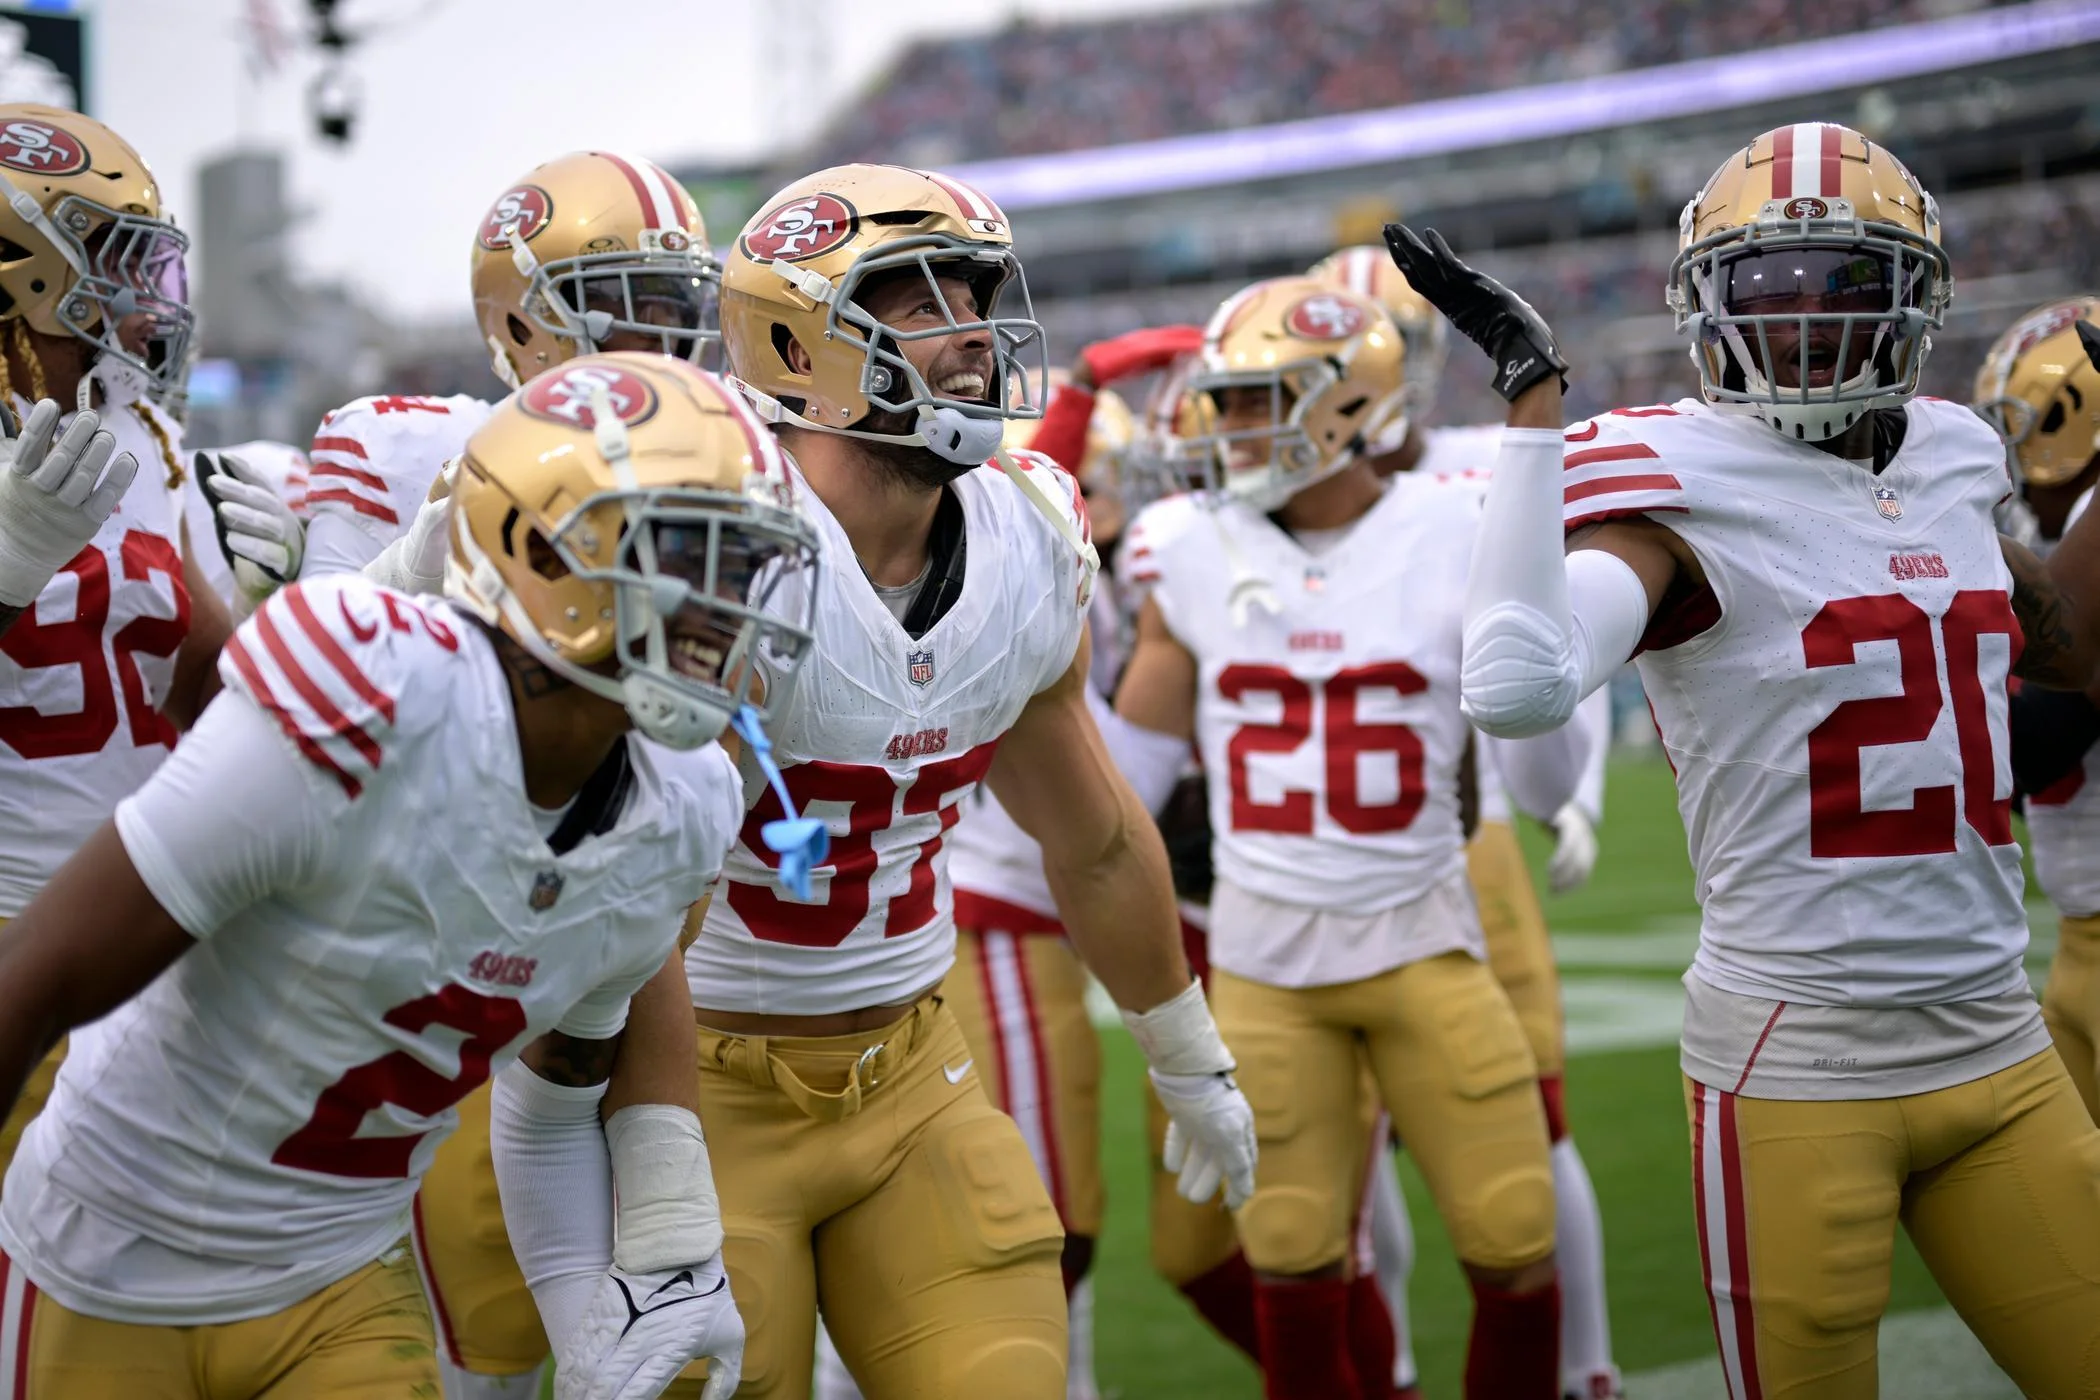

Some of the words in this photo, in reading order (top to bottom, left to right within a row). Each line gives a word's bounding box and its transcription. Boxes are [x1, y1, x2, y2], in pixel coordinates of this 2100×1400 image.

[766, 199, 833, 254] SF
[1889, 553, 1949, 581] 49ERS
[0, 528, 191, 760] 92
[912, 664, 932, 680] NFL
[885, 727, 949, 760] 49ERS
[1217, 657, 1429, 836] 26
[1801, 589, 2025, 858] 20
[727, 728, 1010, 947] 97
[272, 982, 527, 1178] 2
[1813, 1057, 1858, 1067] DRI-FIT
